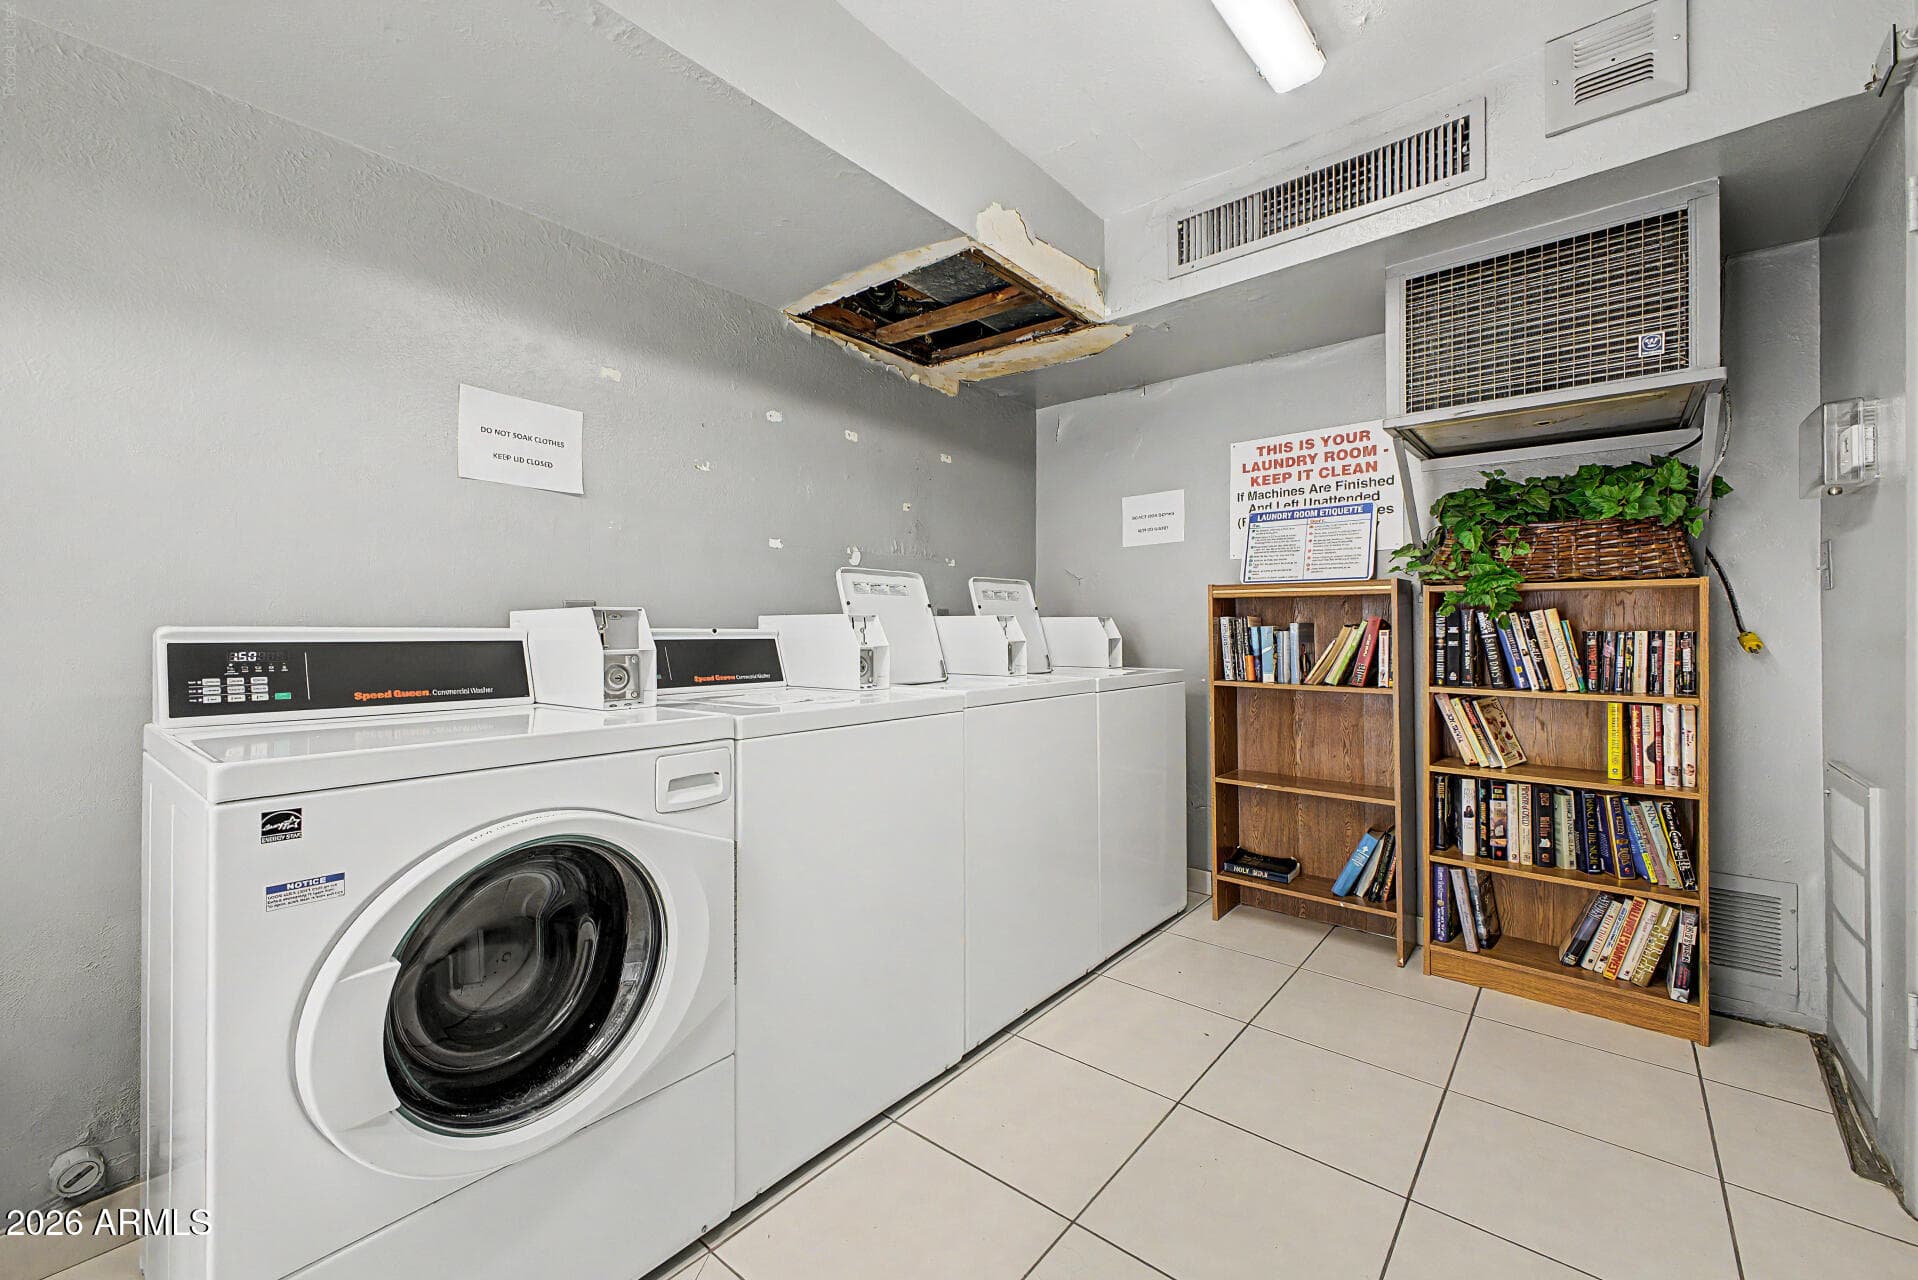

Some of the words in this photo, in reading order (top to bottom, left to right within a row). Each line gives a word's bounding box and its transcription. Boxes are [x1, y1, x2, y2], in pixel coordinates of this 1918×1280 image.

[480, 426, 493, 434] DO
[494, 429, 511, 438] NOT
[512, 432, 533, 442] SOAK
[534, 437, 565, 448] CLOTHES
[1256, 441, 1293, 457] THIS
[1299, 438, 1315, 450] IS
[1320, 430, 1371, 448] YOUR
[493, 452, 512, 461] KEEP
[513, 456, 525, 464] LID
[526, 458, 554, 469] CLOSED
[1242, 453, 1318, 474] LAUNDRY
[1324, 445, 1377, 463] ROOM
[1250, 472, 1292, 487] KEEP
[1297, 469, 1313, 481] IT
[1318, 460, 1378, 479] CLEAN
[1237, 491, 1245, 502] If
[1247, 487, 1305, 502] Machines
[1309, 483, 1332, 494] Are
[1335, 474, 1395, 492] Finished
[1248, 501, 1273, 513] And
[1257, 511, 1293, 522] LAUNDRY
[1293, 509, 1318, 519] ROOM
[1320, 505, 1364, 516] ETIQUETTE
[354, 690, 392, 701] Speed
[393, 689, 430, 698] Queen
[432, 688, 470, 696] Commercial
[470, 687, 494, 695] Washer
[1645, 805, 1660, 828] NINA
[287, 877, 327, 890] NOTICE
[1619, 900, 1644, 944] HALLIWELL'S
[1607, 943, 1625, 976] HARVEST
